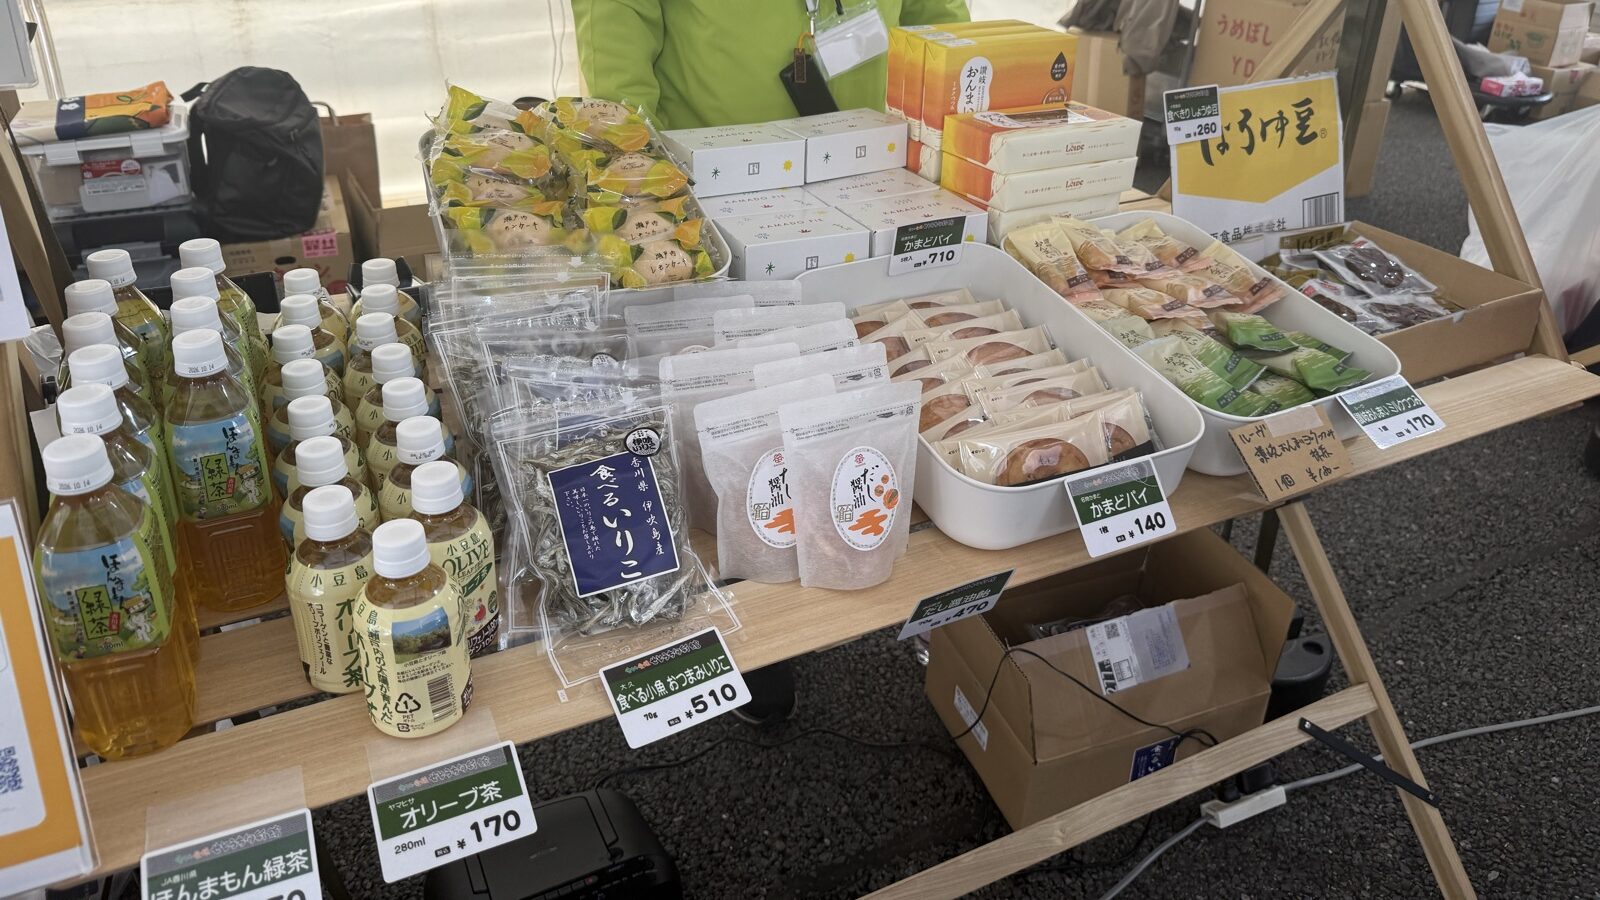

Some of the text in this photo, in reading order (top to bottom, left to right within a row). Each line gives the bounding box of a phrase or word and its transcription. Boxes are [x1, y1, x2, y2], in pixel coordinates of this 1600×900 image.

[1217, 15, 1273, 46] うめぼし
[1168, 104, 1218, 121] 食べきり しょうゆ豆
[883, 205, 925, 215] KAMADO
[504, 215, 527, 223] 瀬戸内
[635, 220, 658, 229] 瀬戸内
[759, 220, 804, 229] KAMADO
[904, 234, 953, 251] かまどパイ
[656, 251, 676, 260] 瀬戸内
[650, 259, 686, 273] レモンケーキ
[1309, 445, 1333, 462] 抹茶
[204, 459, 229, 497] 緑茶
[861, 464, 879, 503] だし
[1275, 474, 1295, 491] 1個
[631, 457, 649, 492] 香川県
[642, 500, 664, 556] 伊吹島産
[1090, 487, 1148, 518] かまどパイ
[590, 464, 642, 580] 食べるいりこ
[1099, 526, 1109, 534] 1枚
[447, 533, 480, 556] 小豆島
[442, 539, 490, 576] OLIVE
[310, 565, 369, 588] 小豆島
[81, 591, 111, 636] 緑茶
[616, 655, 730, 711] 食べる小魚 おつまみいりこ
[620, 681, 634, 690] 大久
[644, 712, 658, 721] 70g
[388, 797, 415, 811] ヤマヒサ
[400, 780, 503, 829] オリーブ茶
[394, 837, 426, 855] 280ml
[148, 848, 309, 900] ほんまもん緑茶
[161, 869, 198, 886] JA香川県
